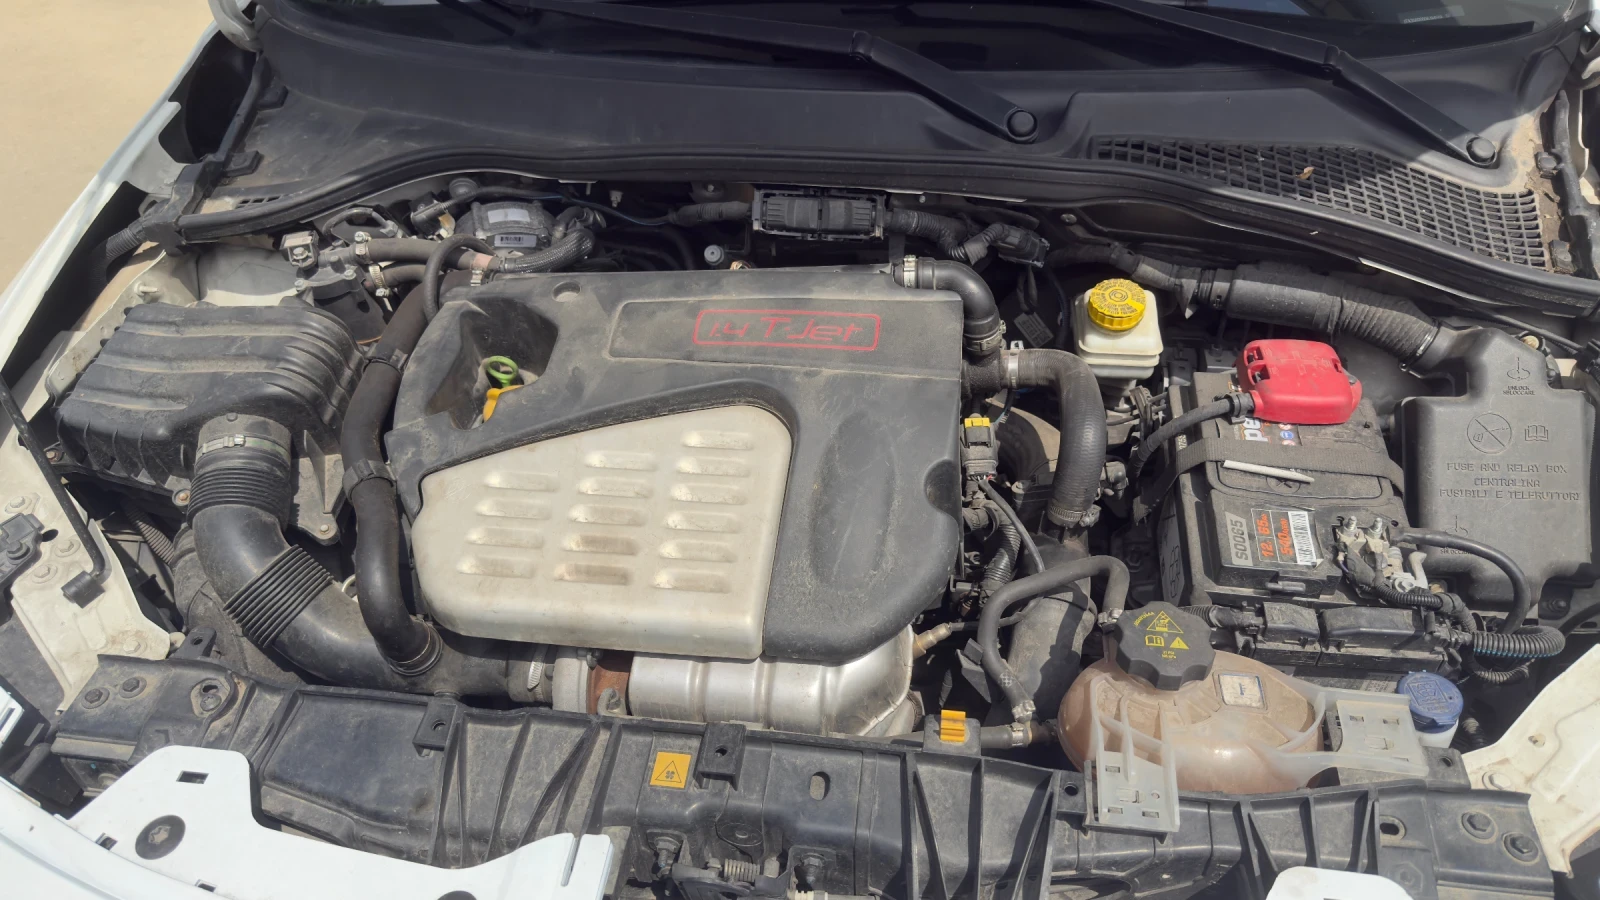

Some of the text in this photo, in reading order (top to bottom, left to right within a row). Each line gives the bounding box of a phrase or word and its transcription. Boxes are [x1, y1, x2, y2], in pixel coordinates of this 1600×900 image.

[1446, 462, 1568, 474] FUSE AND RELAY BOX
[1474, 477, 1540, 488] CENTRALINA
[1439, 488, 1488, 499] FUSIBILI
[1495, 490, 1503, 499] E
